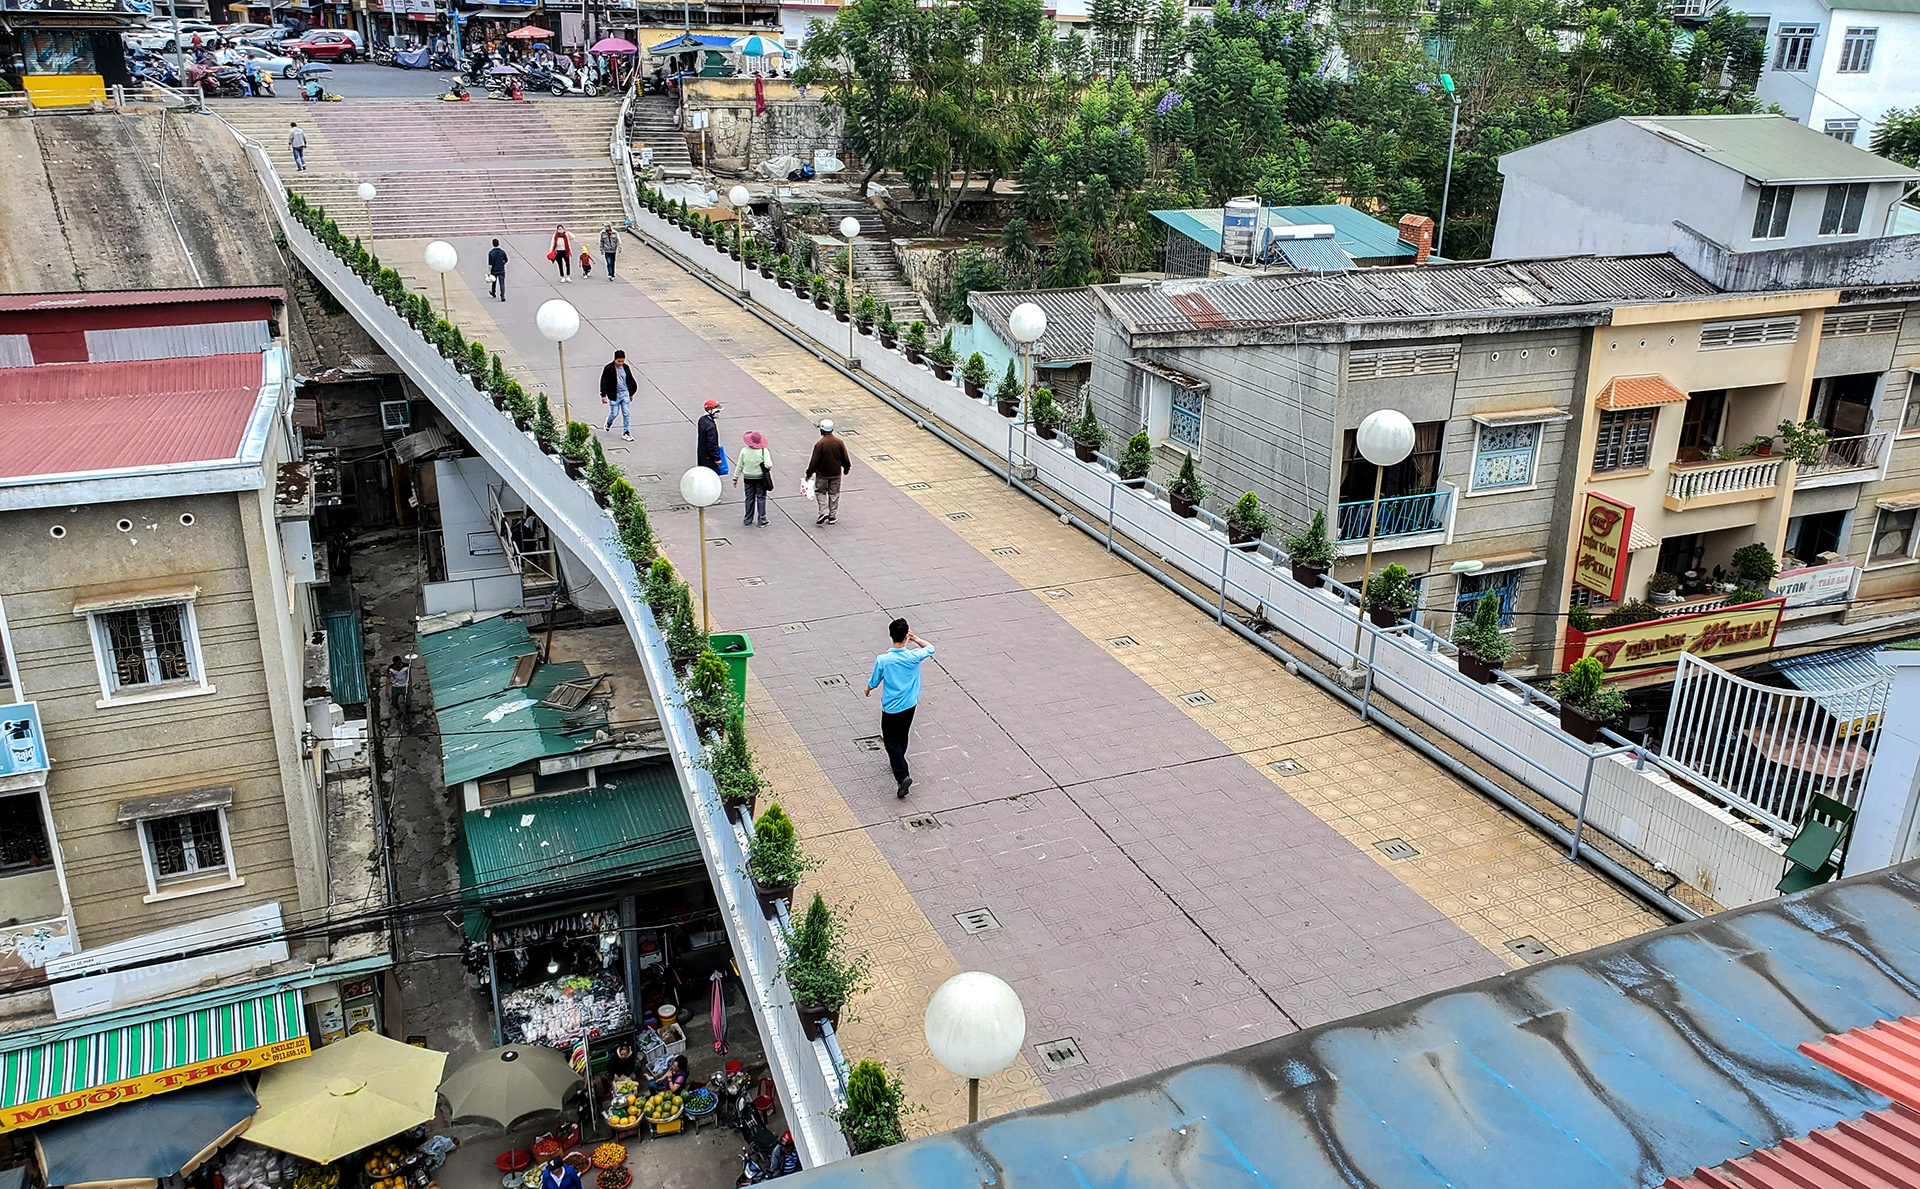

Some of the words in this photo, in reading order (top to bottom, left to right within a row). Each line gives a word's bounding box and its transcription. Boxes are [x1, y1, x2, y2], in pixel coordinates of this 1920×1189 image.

[1599, 541, 1616, 558] VÀNG
[12, 1083, 143, 1126] MƯỜI
[155, 1058, 252, 1088] THỌ
